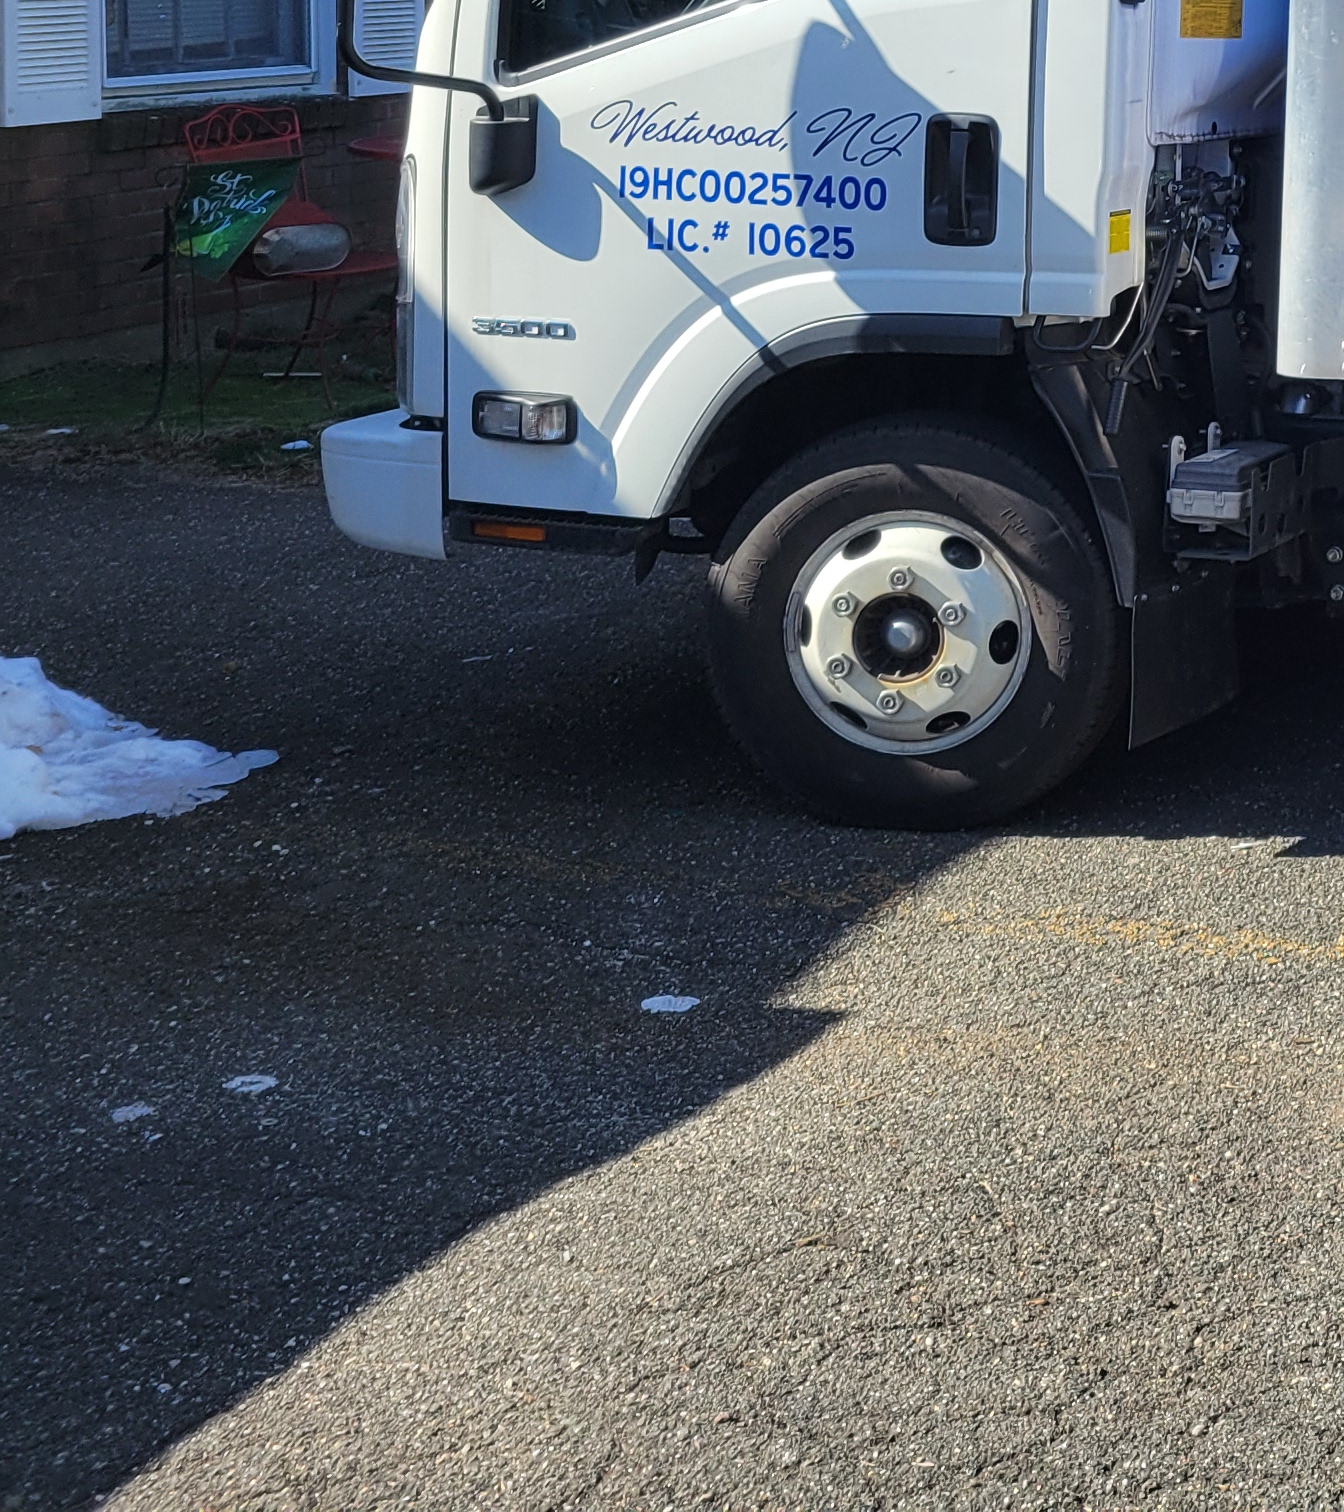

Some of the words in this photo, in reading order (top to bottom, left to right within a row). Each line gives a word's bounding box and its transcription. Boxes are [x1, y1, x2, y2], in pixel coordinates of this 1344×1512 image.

[590, 99, 798, 153] Westwood,
[806, 107, 922, 167] NJ
[618, 165, 888, 211] 19HC00257400
[646, 217, 731, 255] LIC.#
[748, 222, 856, 260] 10625
[472, 316, 568, 338] 3500
